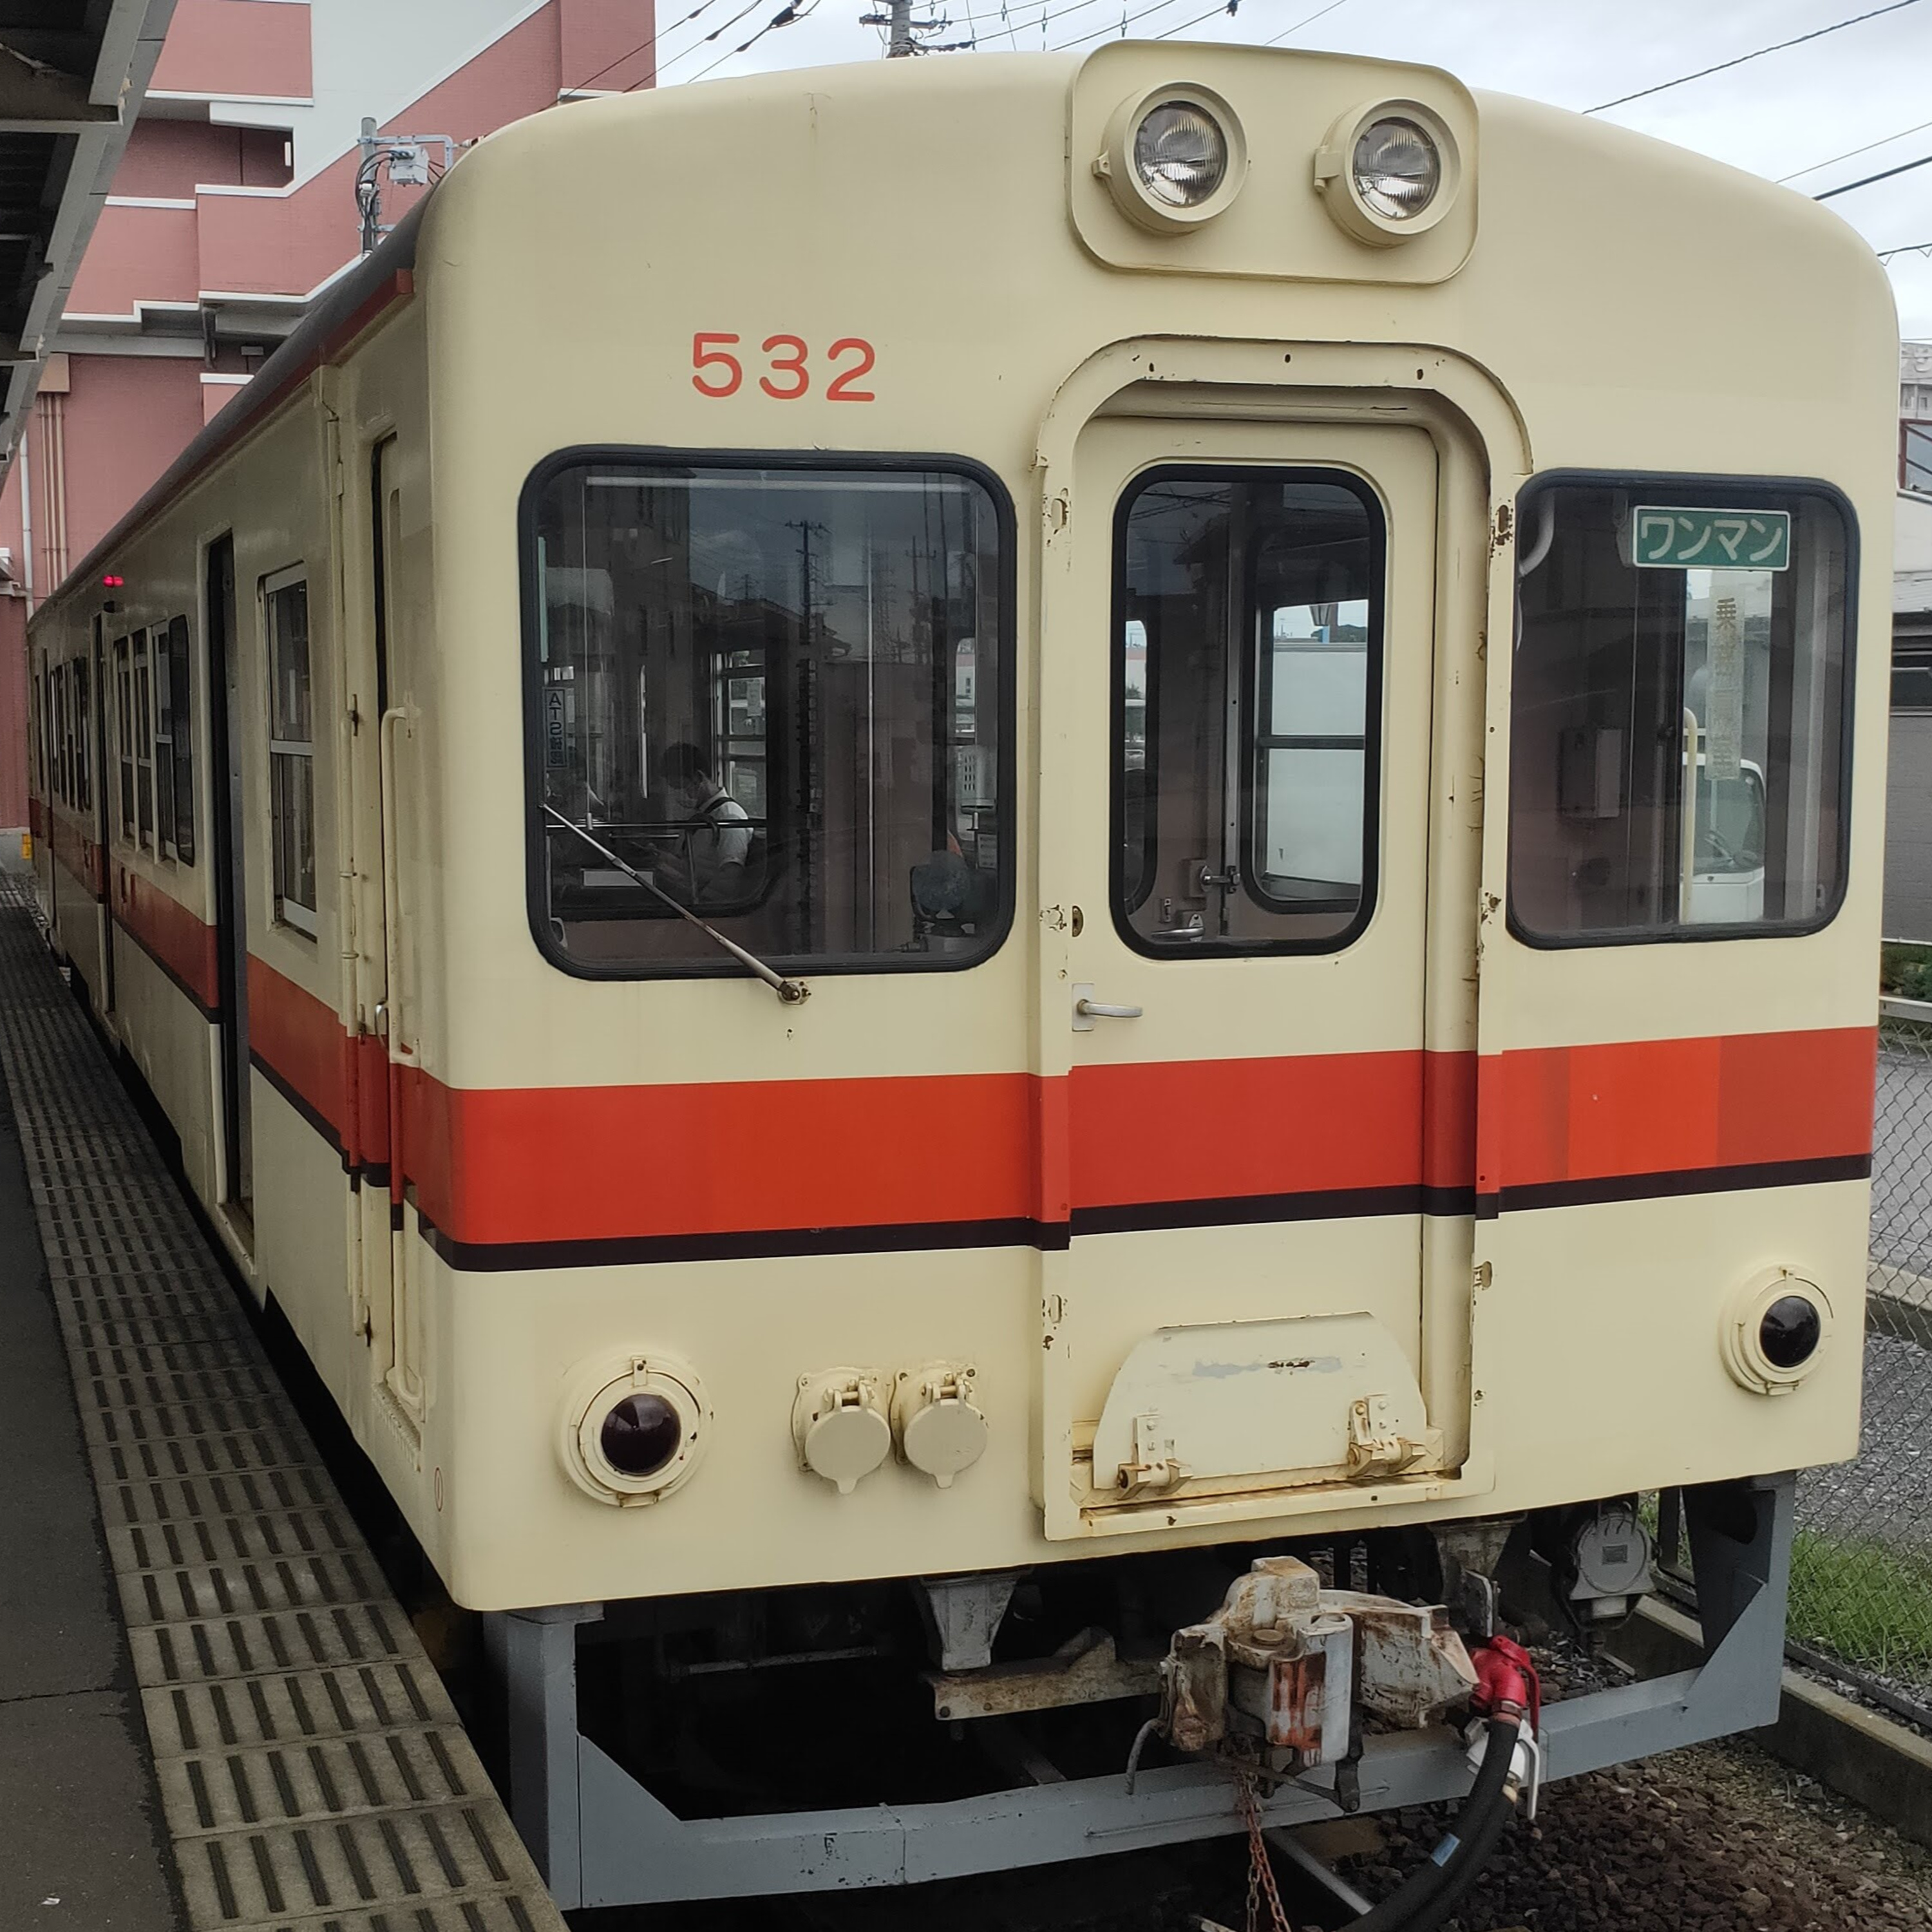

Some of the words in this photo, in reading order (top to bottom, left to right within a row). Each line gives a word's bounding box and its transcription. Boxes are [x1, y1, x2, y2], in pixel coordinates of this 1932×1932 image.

[692, 332, 876, 402] 532
[1640, 516, 1783, 562] ワンマン
